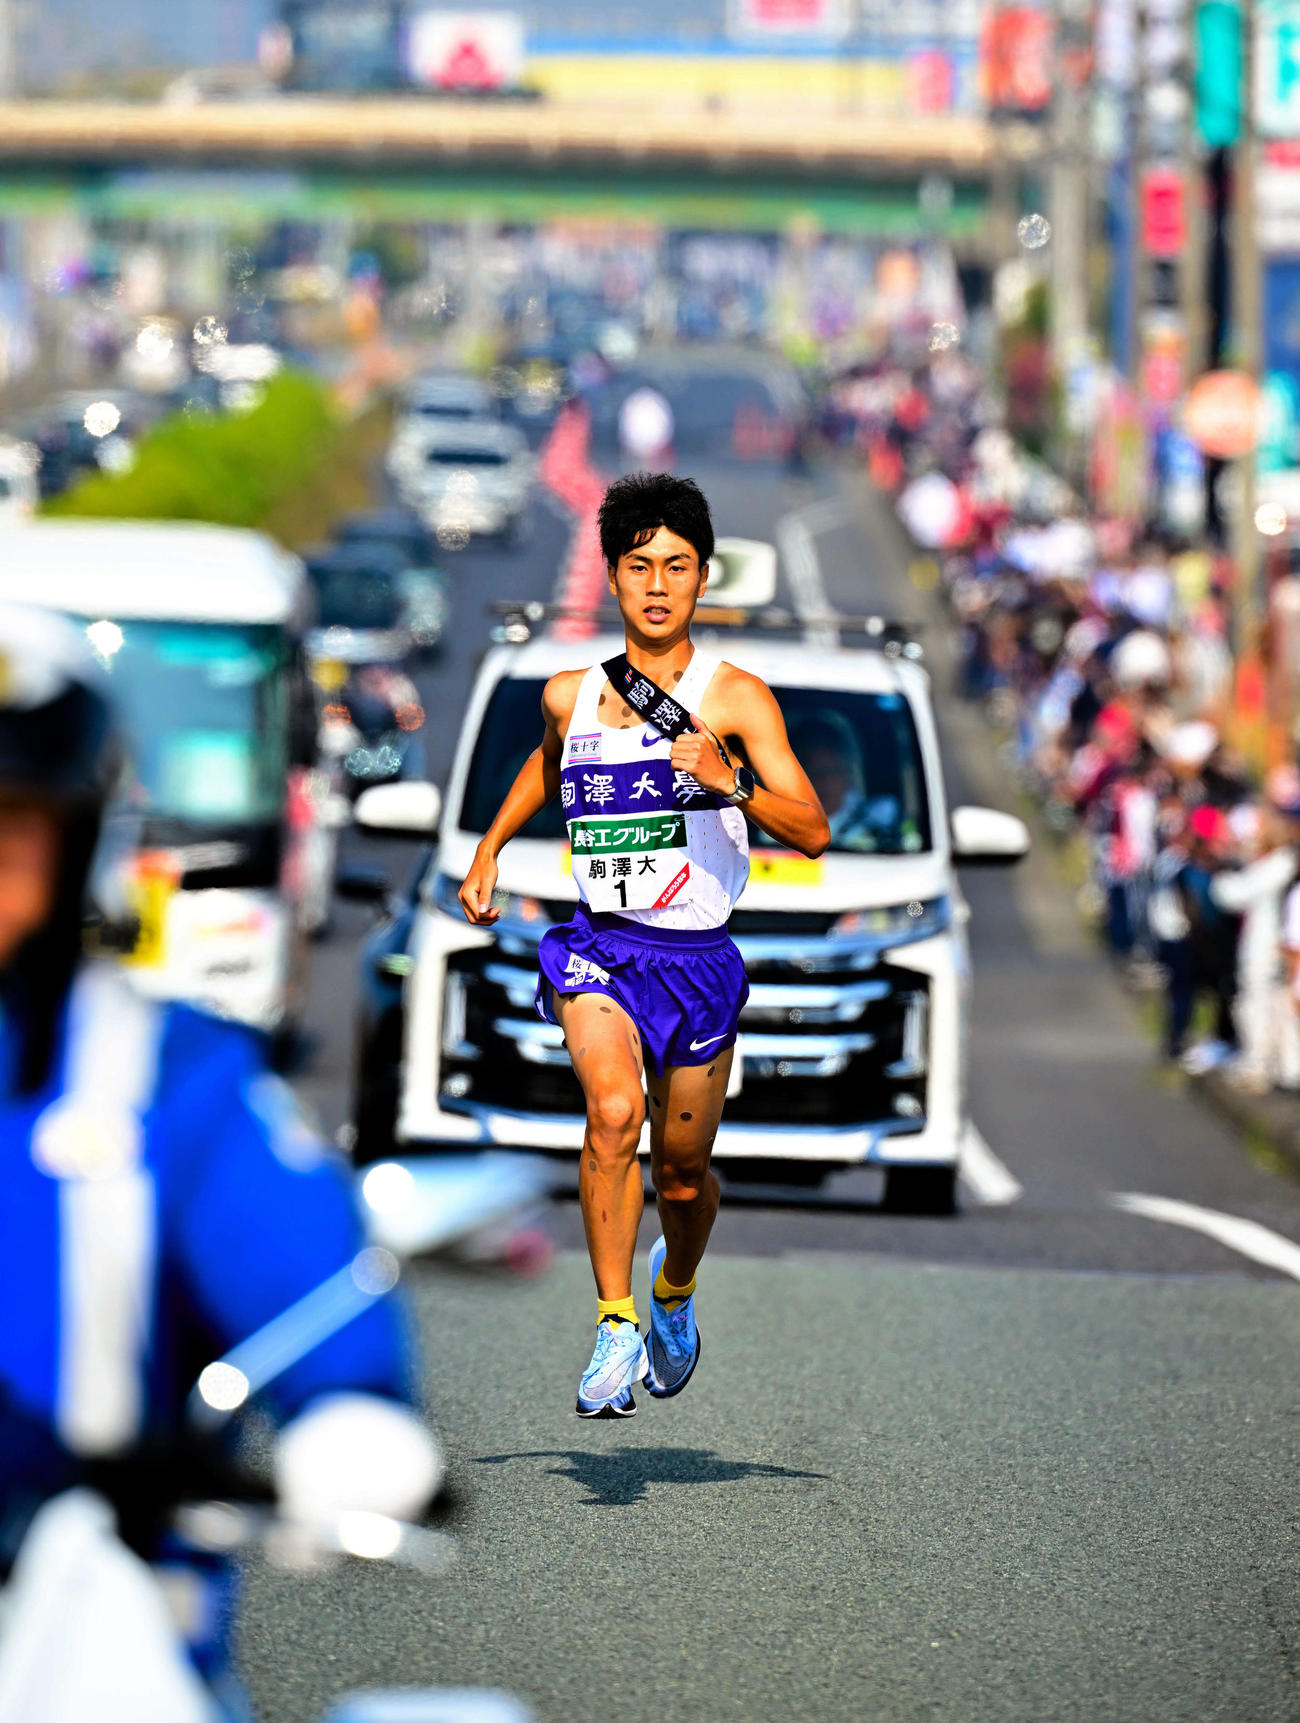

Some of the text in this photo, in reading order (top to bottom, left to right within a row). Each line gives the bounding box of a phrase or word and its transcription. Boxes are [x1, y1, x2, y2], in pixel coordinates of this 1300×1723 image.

[626, 678, 699, 734] 駒澤
[570, 740, 599, 753] 桜十字
[573, 821, 681, 847] 長谷工グループ
[588, 855, 657, 879] 駒澤大
[614, 880, 627, 908] 1
